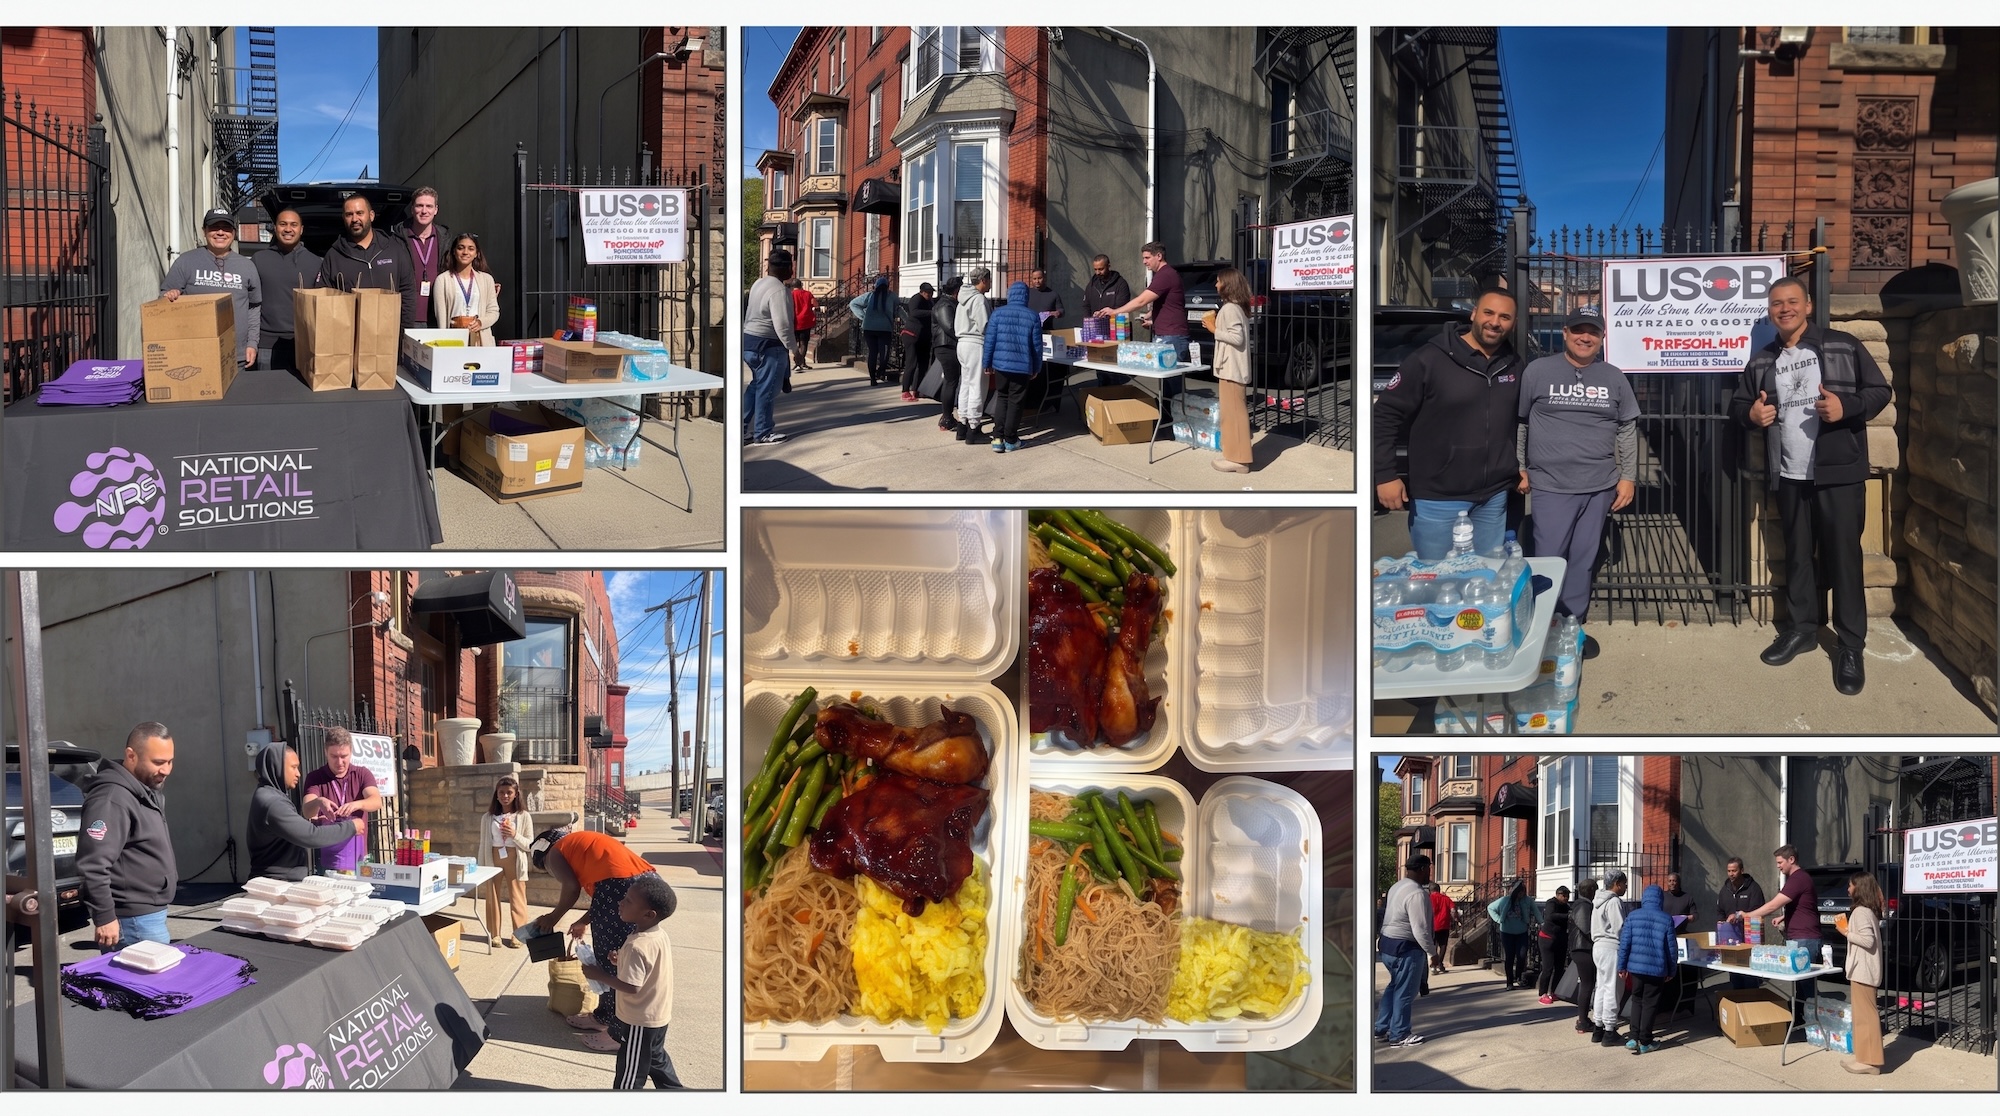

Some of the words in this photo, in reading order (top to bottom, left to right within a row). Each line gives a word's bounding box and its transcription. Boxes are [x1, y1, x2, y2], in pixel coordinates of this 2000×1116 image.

[1279, 221, 1354, 250] LUSO
[180, 453, 313, 478] NATIONAL
[95, 476, 157, 518] NRS
[180, 473, 313, 506] RETAIL
[179, 499, 314, 527] SOLUTIONS
[353, 738, 391, 759] USOB
[328, 983, 410, 1051] NATIONAL
[335, 1001, 424, 1081] RETAIL
